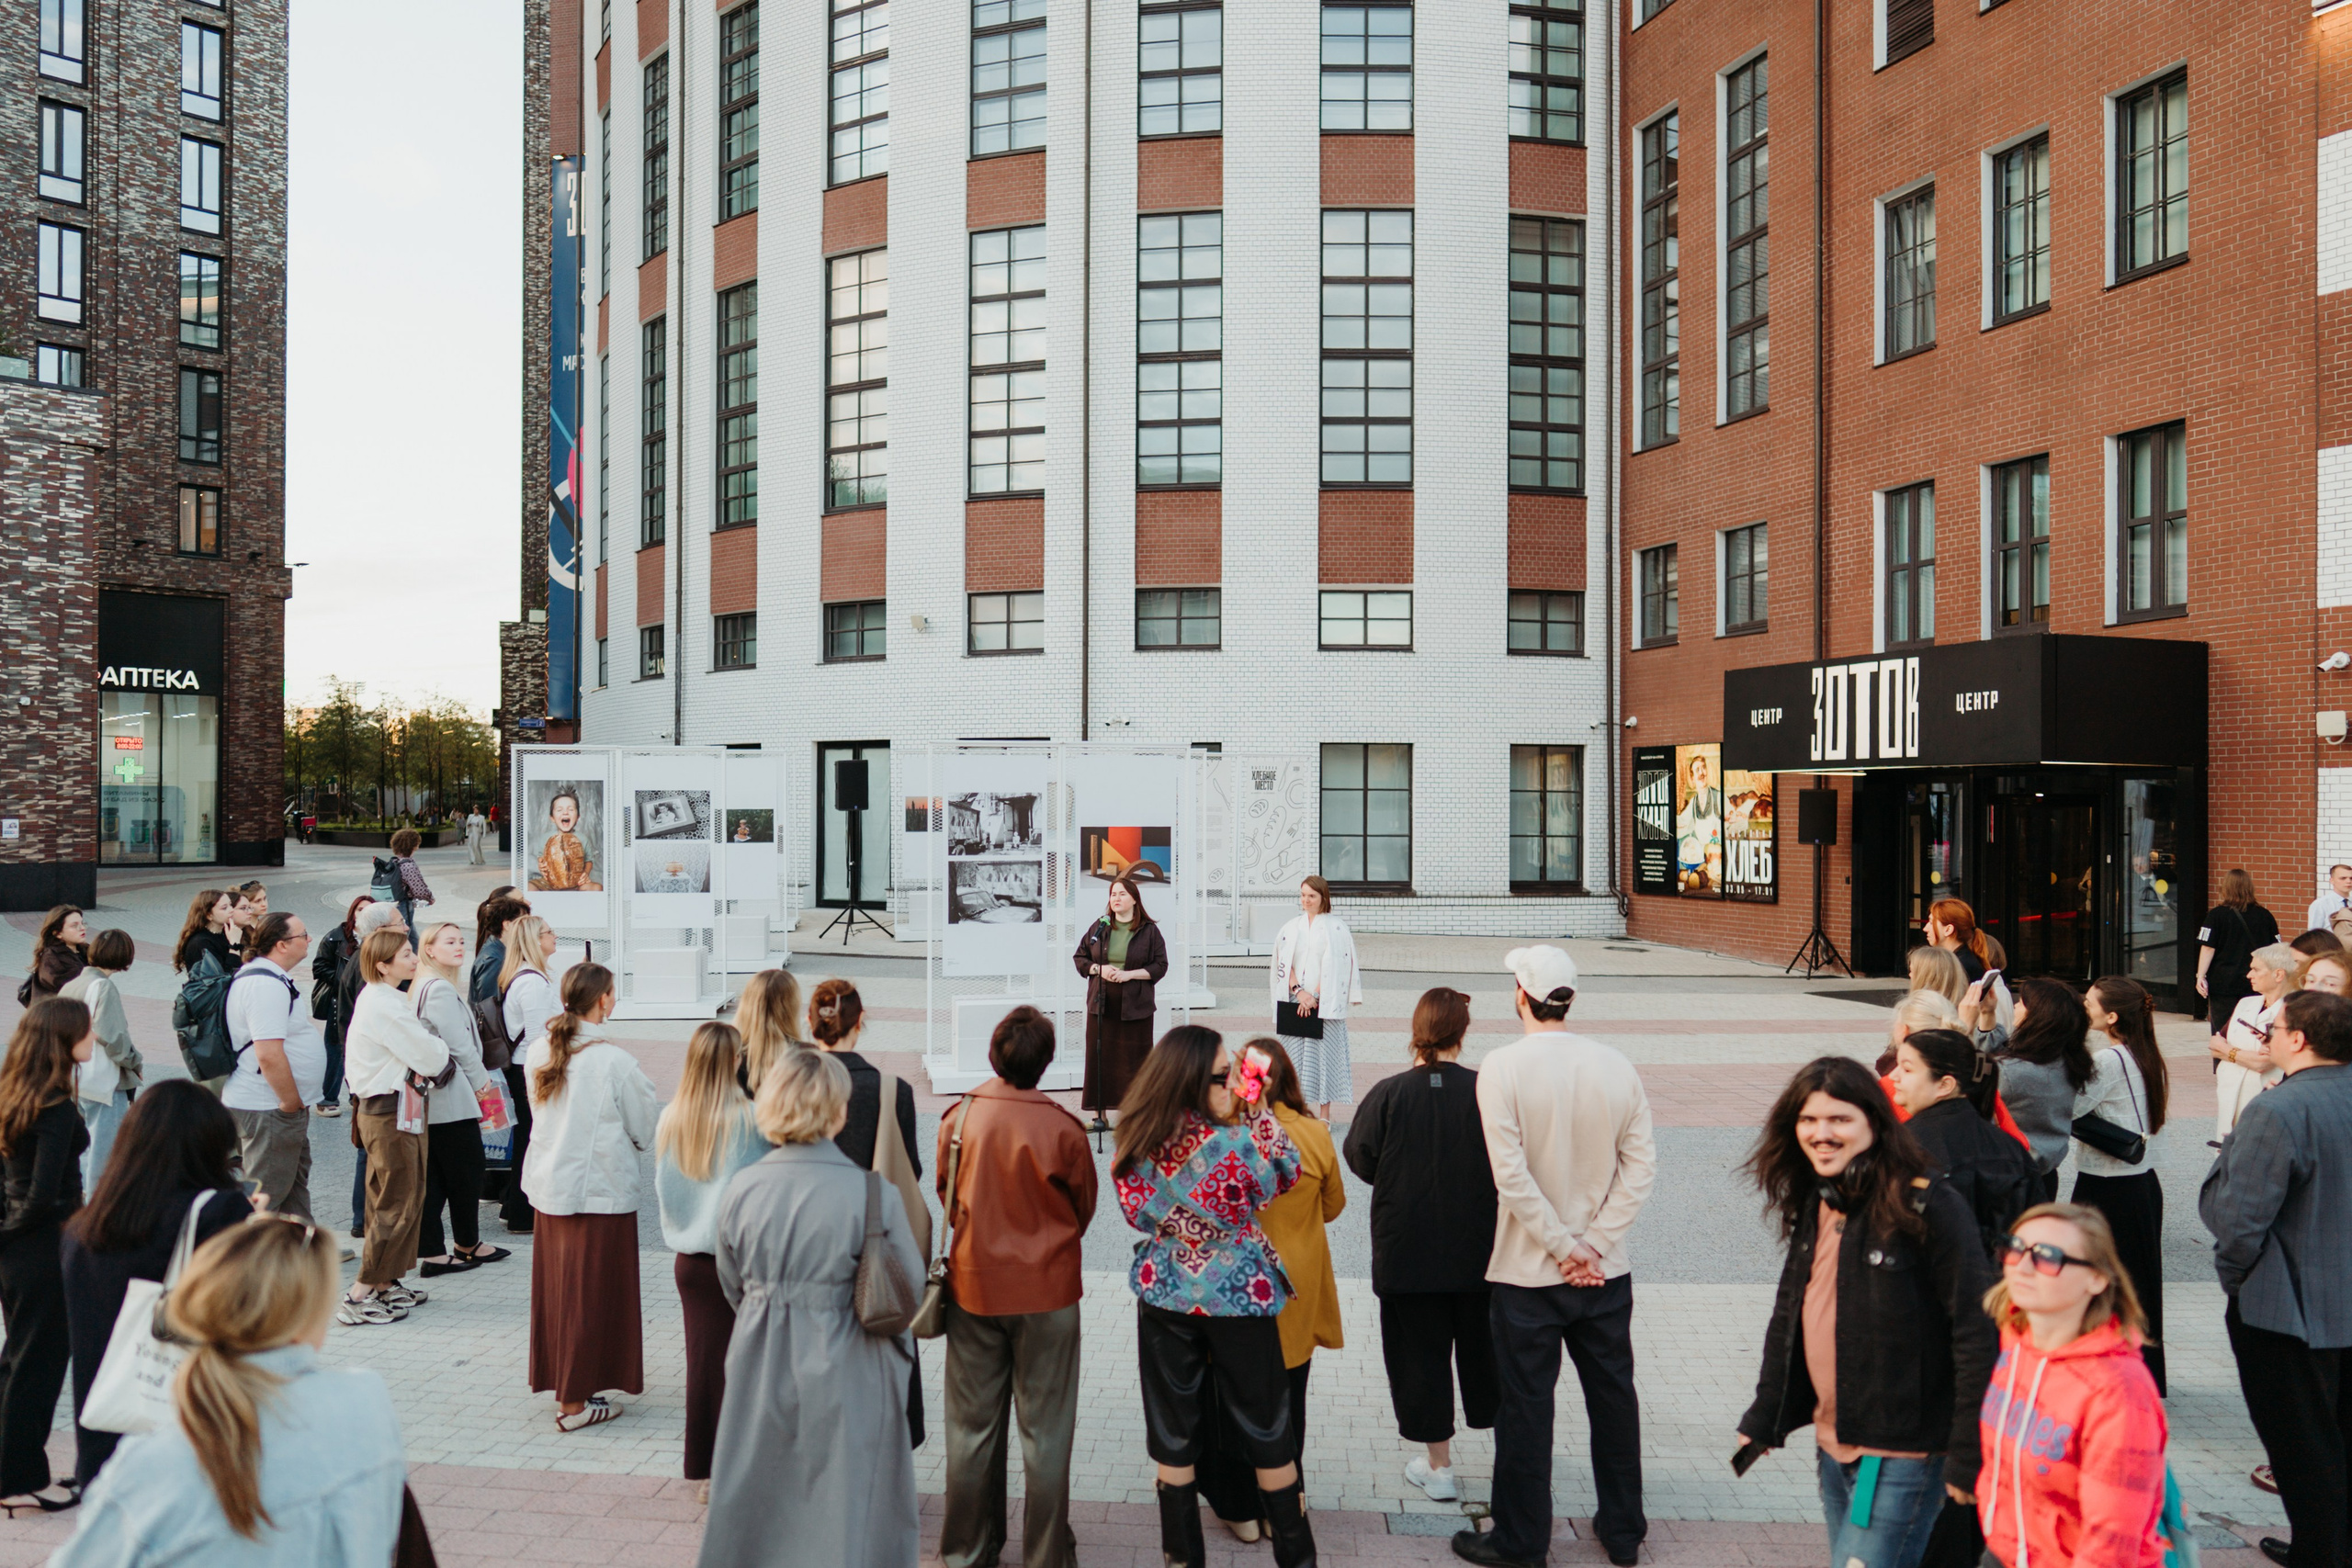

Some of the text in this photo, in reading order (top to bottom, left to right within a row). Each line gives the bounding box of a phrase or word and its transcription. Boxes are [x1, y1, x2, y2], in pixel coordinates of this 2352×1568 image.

[100, 666, 199, 690] АПТЕКА
[1750, 657, 1999, 761] ЦЕНТР ЗОТОВ ЦЕНТР
[1251, 771, 1276, 781] ХЛЕБНОЕ
[1255, 781, 1273, 790] МЕСТО
[1725, 840, 1773, 885] ХЛЕБ
